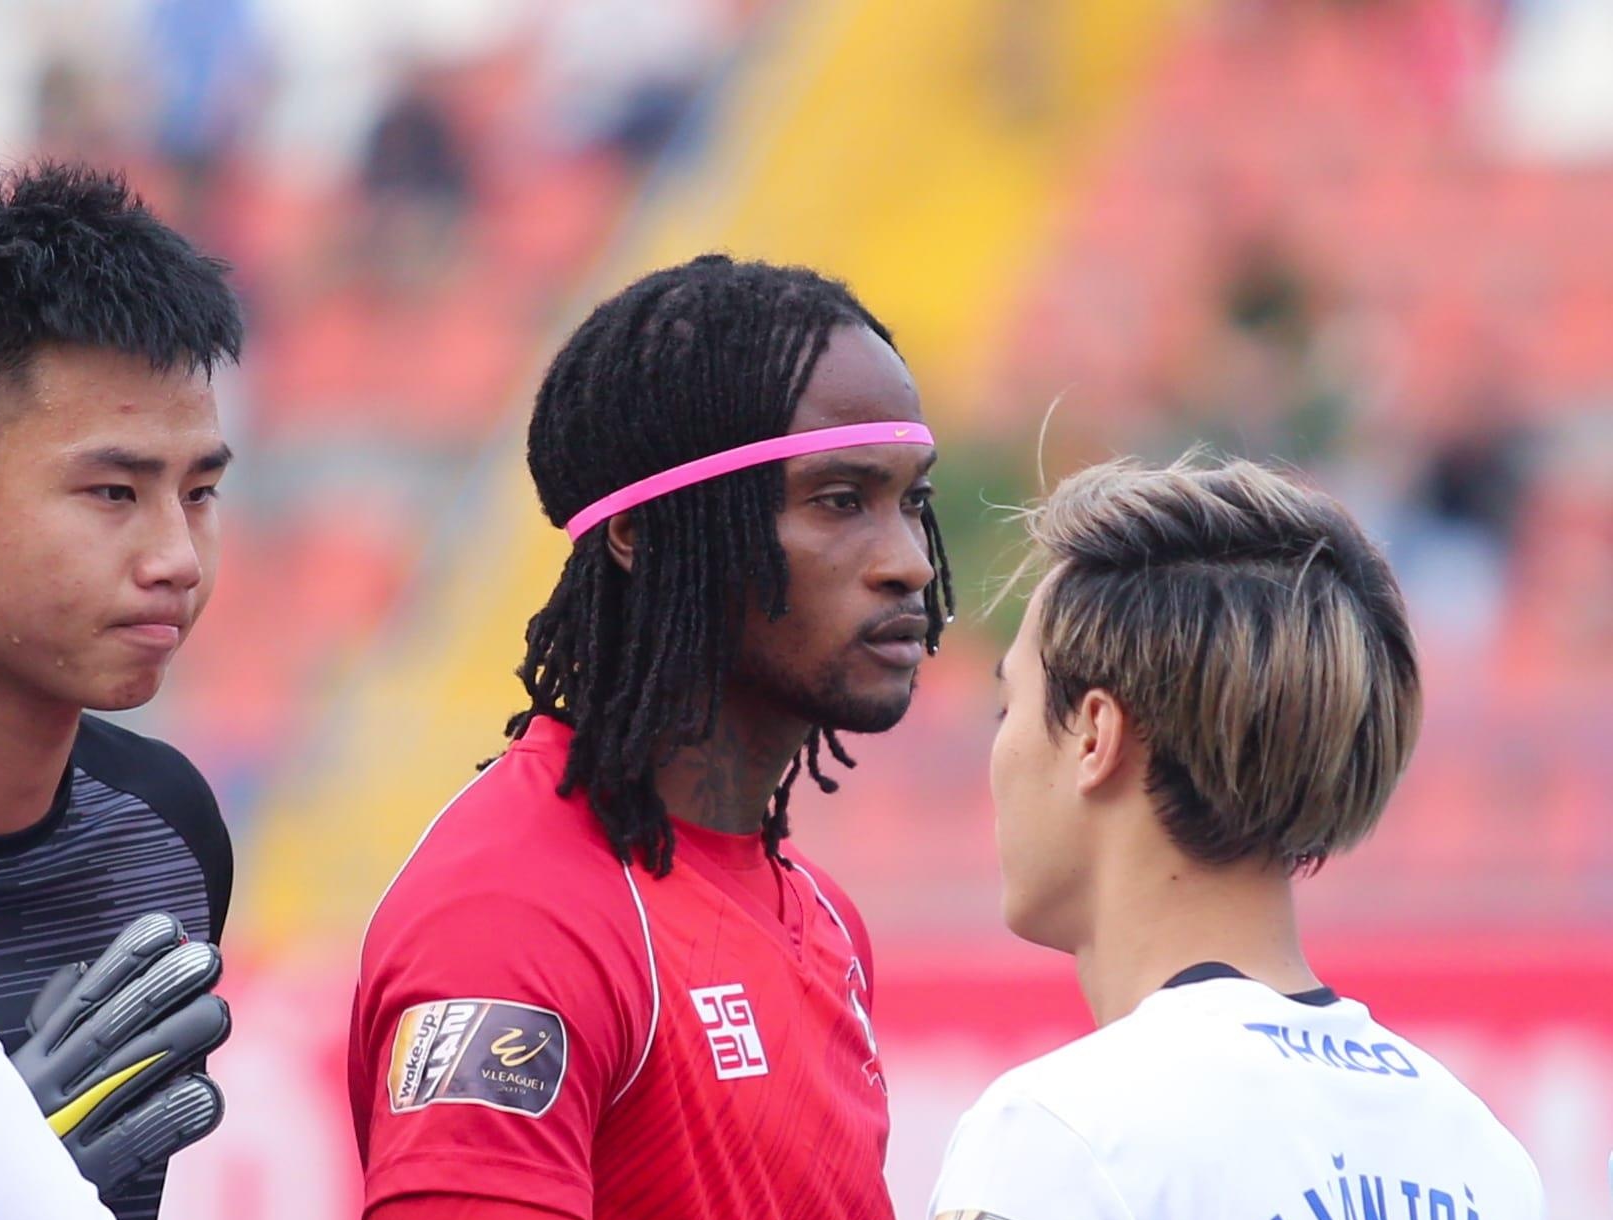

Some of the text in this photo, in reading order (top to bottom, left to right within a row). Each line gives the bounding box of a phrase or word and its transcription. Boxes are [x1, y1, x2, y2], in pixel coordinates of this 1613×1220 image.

[399, 1014, 438, 1099] wake-up
[1244, 1023, 1419, 1078] THACO
[481, 1069, 538, 1090] V.LEAGUE
